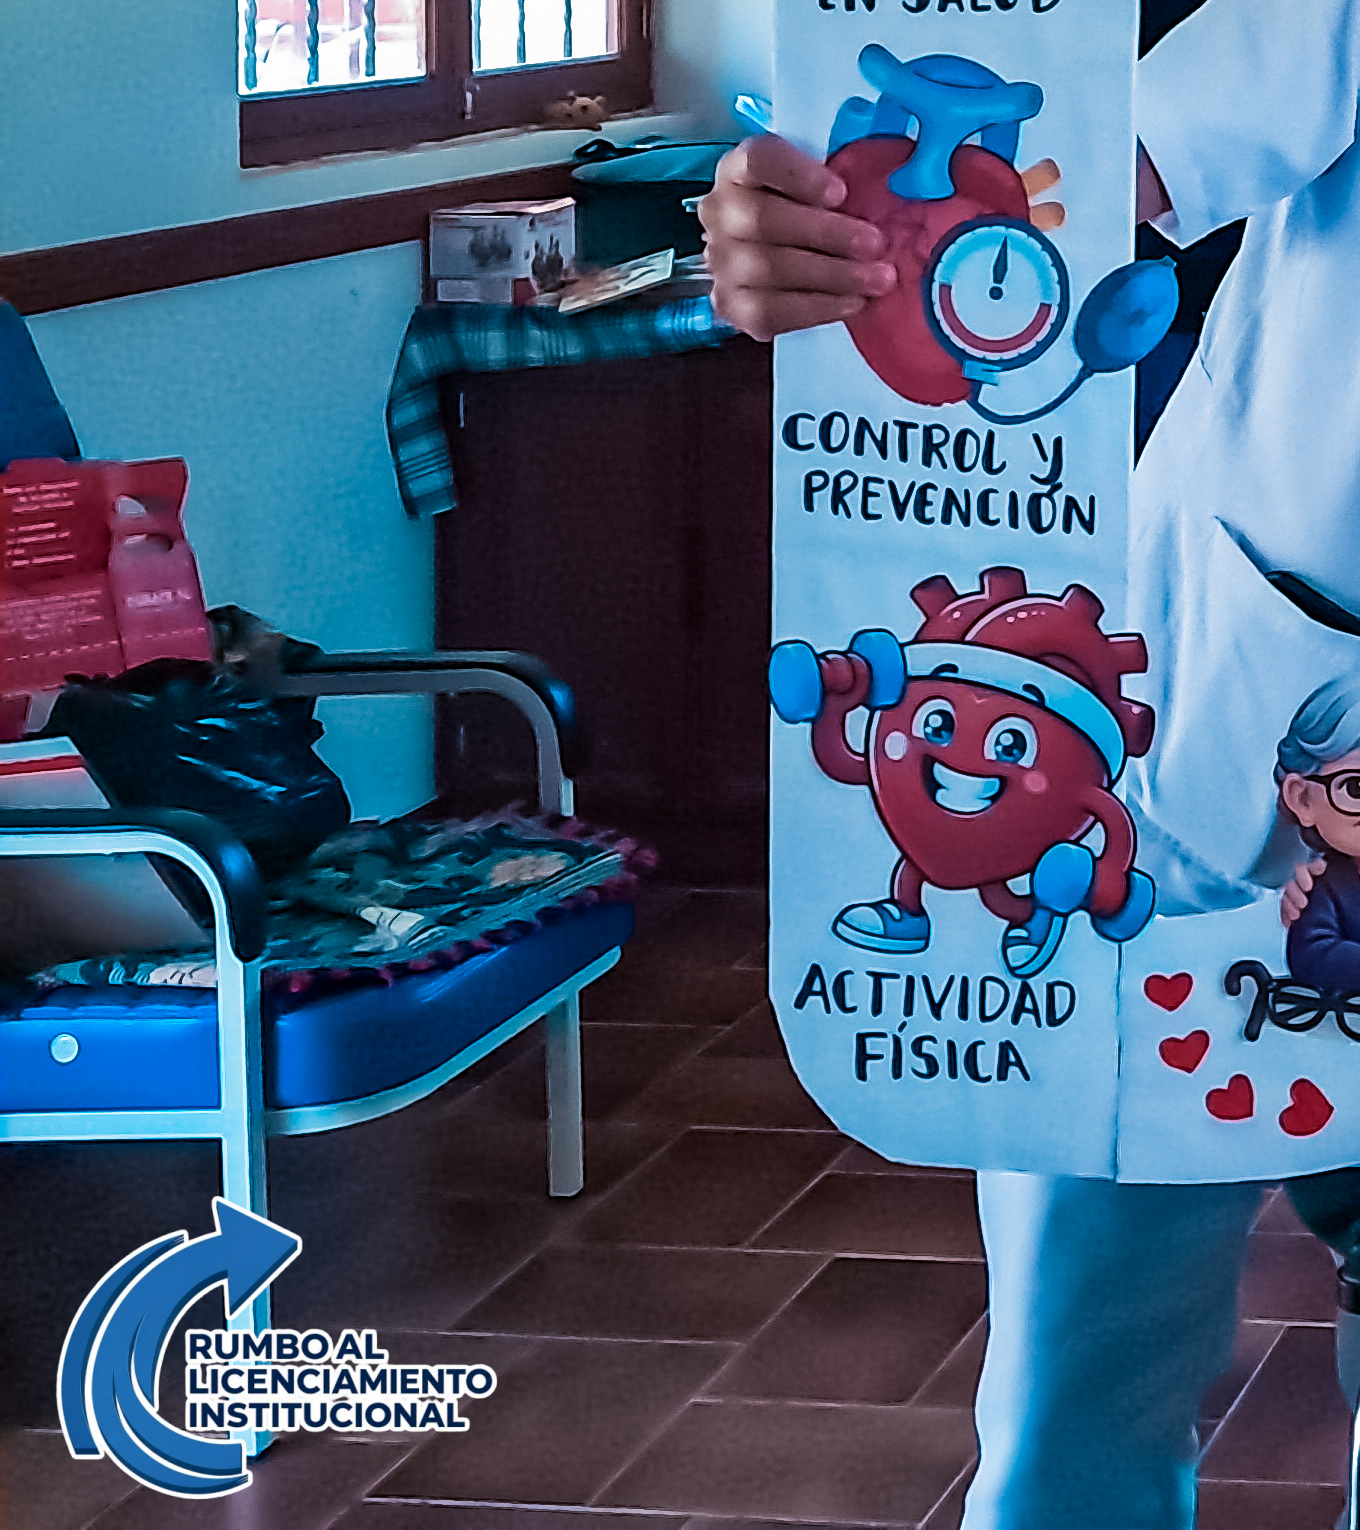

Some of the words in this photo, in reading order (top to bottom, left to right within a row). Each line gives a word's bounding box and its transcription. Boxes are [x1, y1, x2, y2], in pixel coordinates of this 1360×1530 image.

[782, 411, 1006, 475] CONTROL
[803, 470, 1096, 535] PREVENCIÓN
[793, 963, 1076, 1028] ACTIVIDAD
[855, 1021, 1031, 1082] FÍSICA
